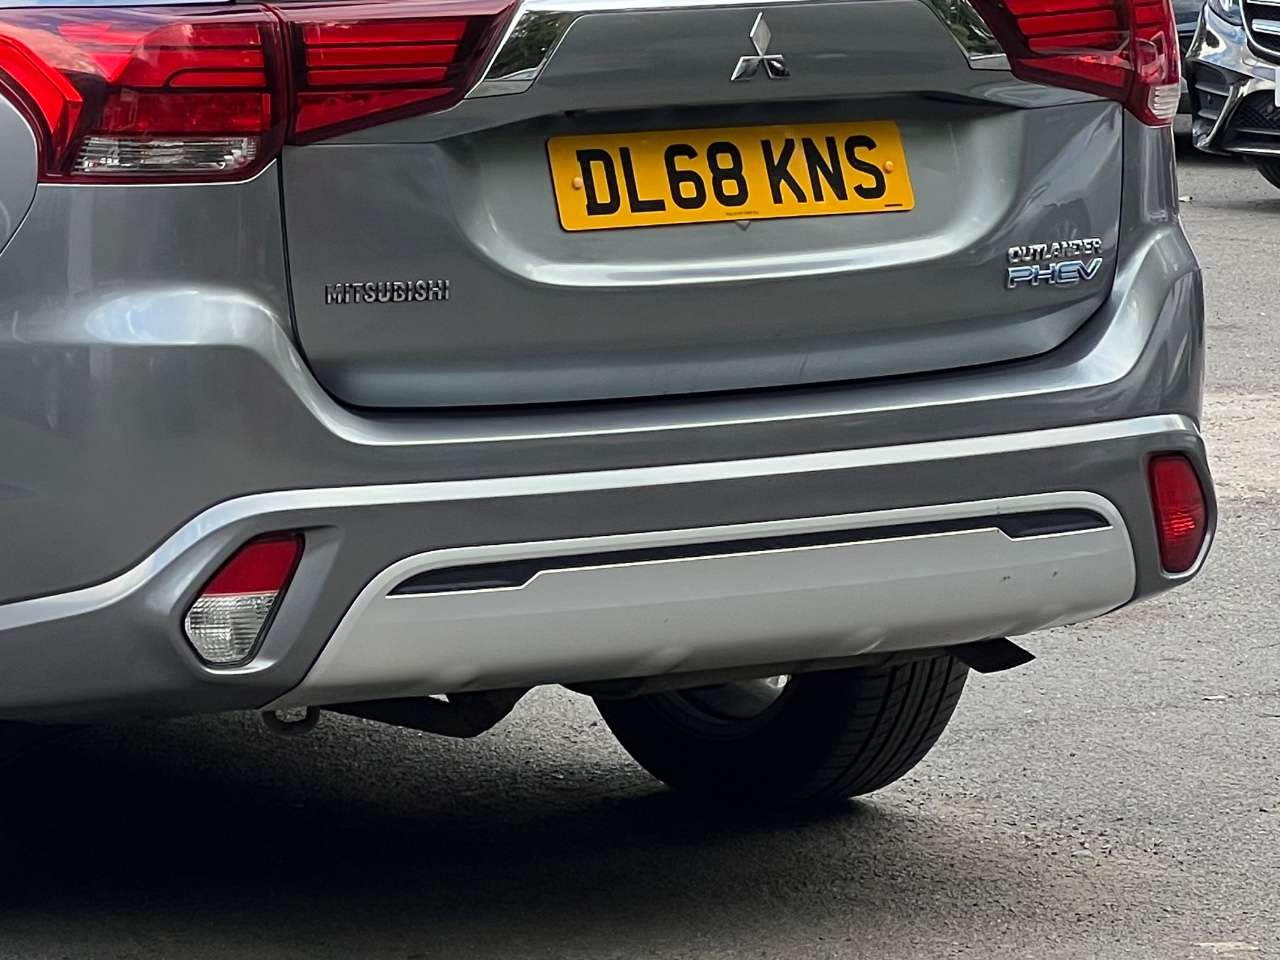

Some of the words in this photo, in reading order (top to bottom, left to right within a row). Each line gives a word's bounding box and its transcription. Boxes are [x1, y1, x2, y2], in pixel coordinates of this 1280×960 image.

[575, 140, 749, 217] DL68
[760, 134, 887, 205] KNS
[1007, 238, 1103, 264] OUTLANDER
[1007, 257, 1103, 289] PHEV
[325, 280, 450, 304] MITSUBISHI
